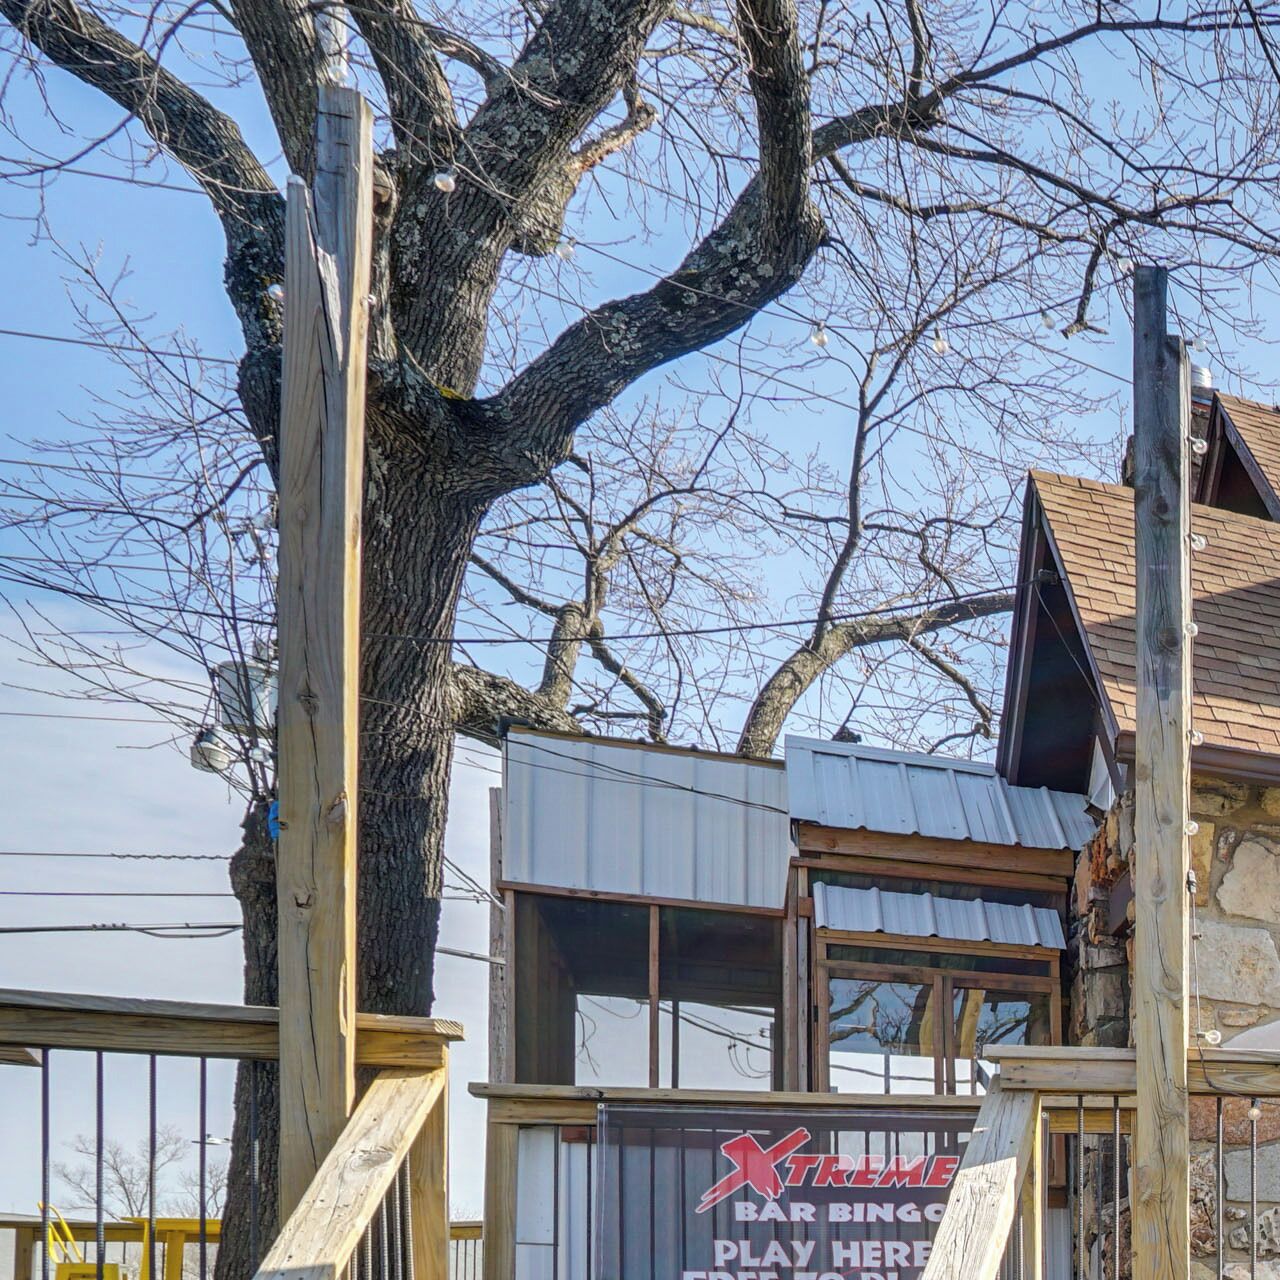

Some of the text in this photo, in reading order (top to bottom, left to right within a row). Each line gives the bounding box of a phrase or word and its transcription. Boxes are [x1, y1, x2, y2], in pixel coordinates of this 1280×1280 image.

[695, 1126, 959, 1214] XTREME
[734, 1202, 946, 1223] BAR BINGO
[714, 1240, 932, 1268] PLAY HERE
